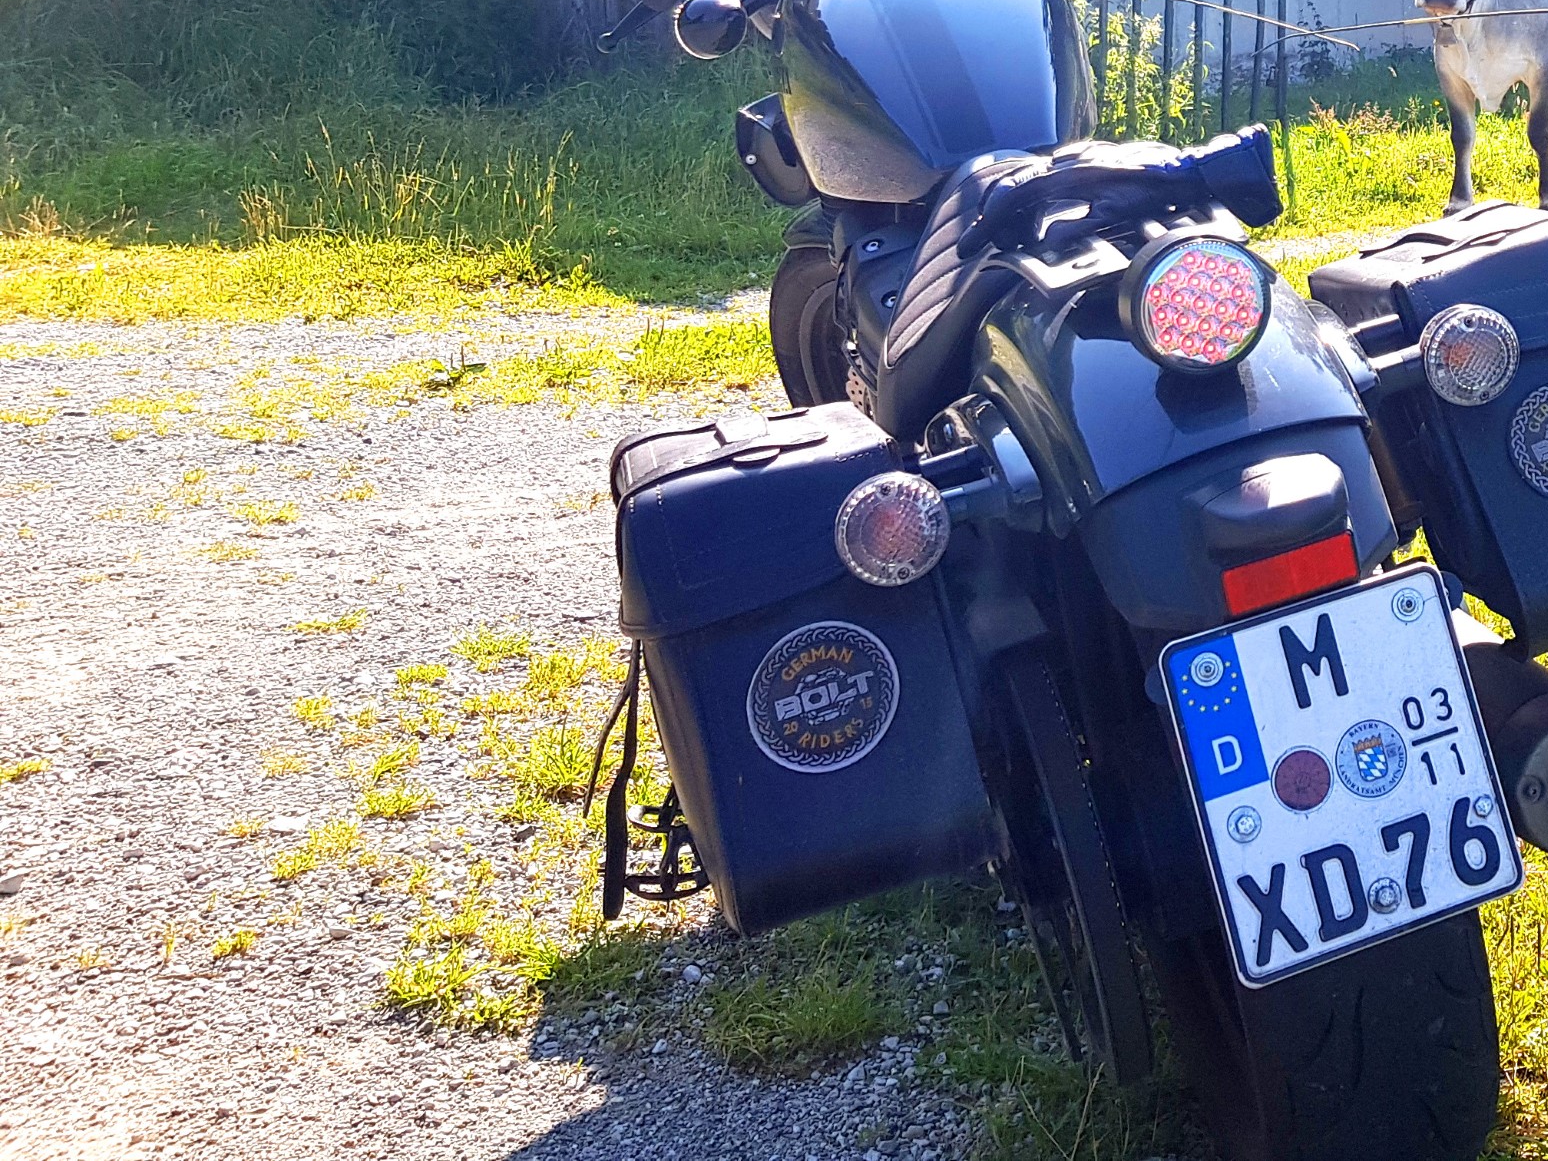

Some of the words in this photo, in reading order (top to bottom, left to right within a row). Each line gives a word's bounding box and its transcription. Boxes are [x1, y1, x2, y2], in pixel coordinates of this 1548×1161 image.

[781, 646, 854, 681] GERMAN
[1278, 612, 1349, 709] M
[774, 671, 874, 721] BOLT
[1402, 687, 1453, 730] 03
[798, 717, 864, 749] RIDERS
[1212, 734, 1242, 774] D
[1421, 743, 1466, 785] 11
